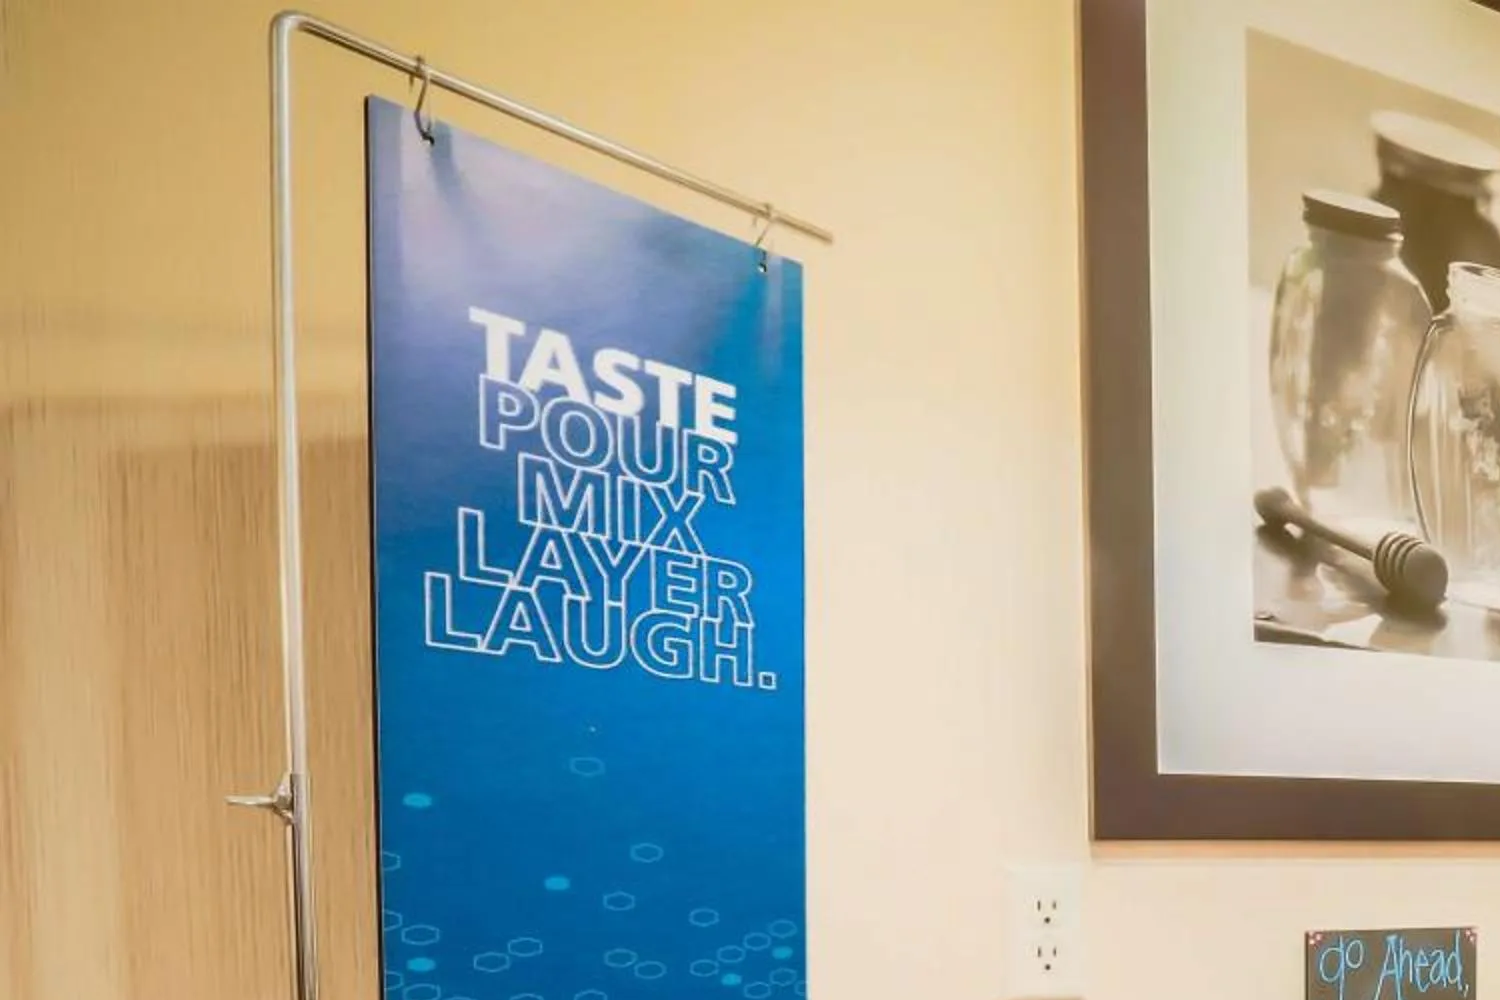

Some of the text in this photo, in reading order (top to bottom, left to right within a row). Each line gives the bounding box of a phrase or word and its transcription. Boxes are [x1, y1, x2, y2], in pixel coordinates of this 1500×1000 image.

[469, 306, 737, 444] TASTE
[479, 373, 736, 504] POUR
[518, 452, 706, 556] MIX
[458, 506, 755, 627] LAYER
[424, 572, 776, 690] LAUGH.
